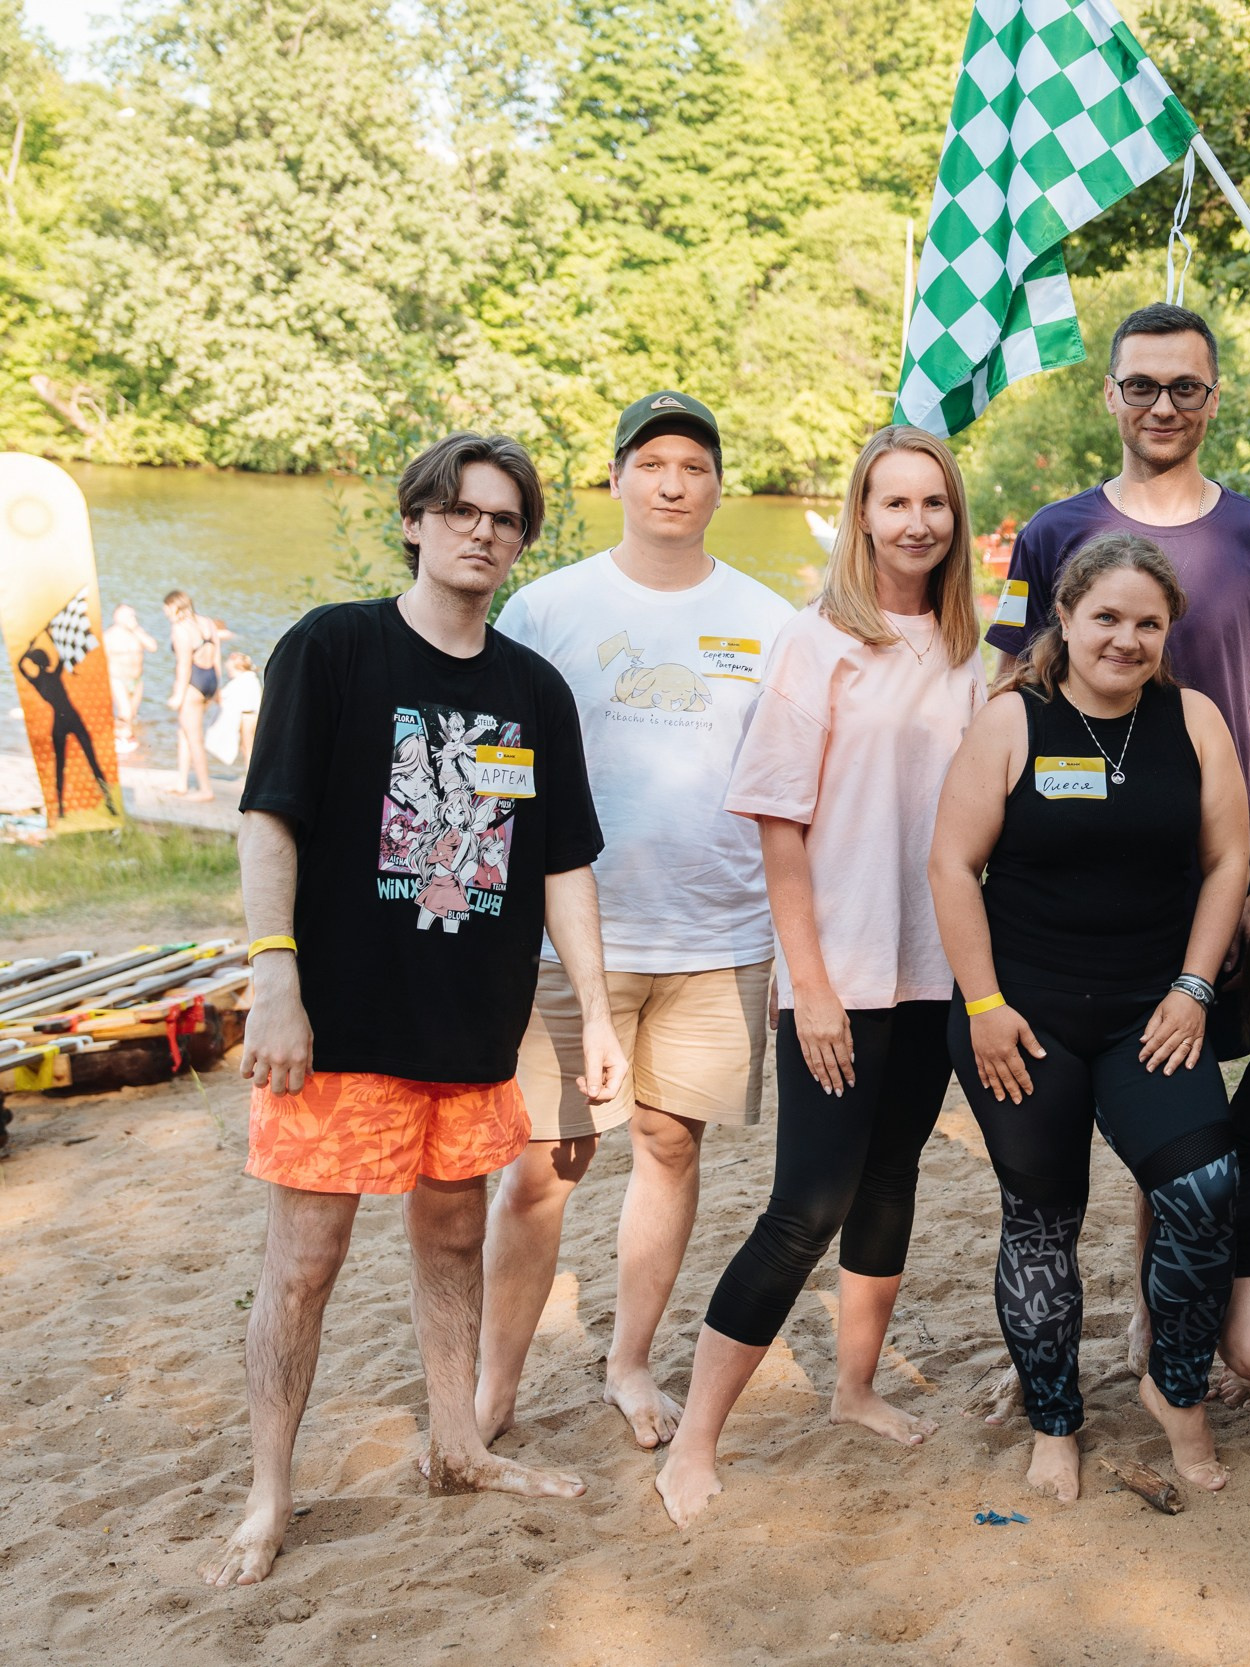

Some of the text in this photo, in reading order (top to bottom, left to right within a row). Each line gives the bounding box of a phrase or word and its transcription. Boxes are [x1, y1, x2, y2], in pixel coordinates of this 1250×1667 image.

[394, 713, 416, 724] FLORA
[478, 718, 496, 728] STELLA
[605, 710, 714, 732] Pikachu is recharging
[481, 768, 527, 787] АРТЕМ
[1043, 776, 1094, 792] Олеся
[467, 887, 503, 917] CLUB
[447, 910, 470, 921] BLOOM
